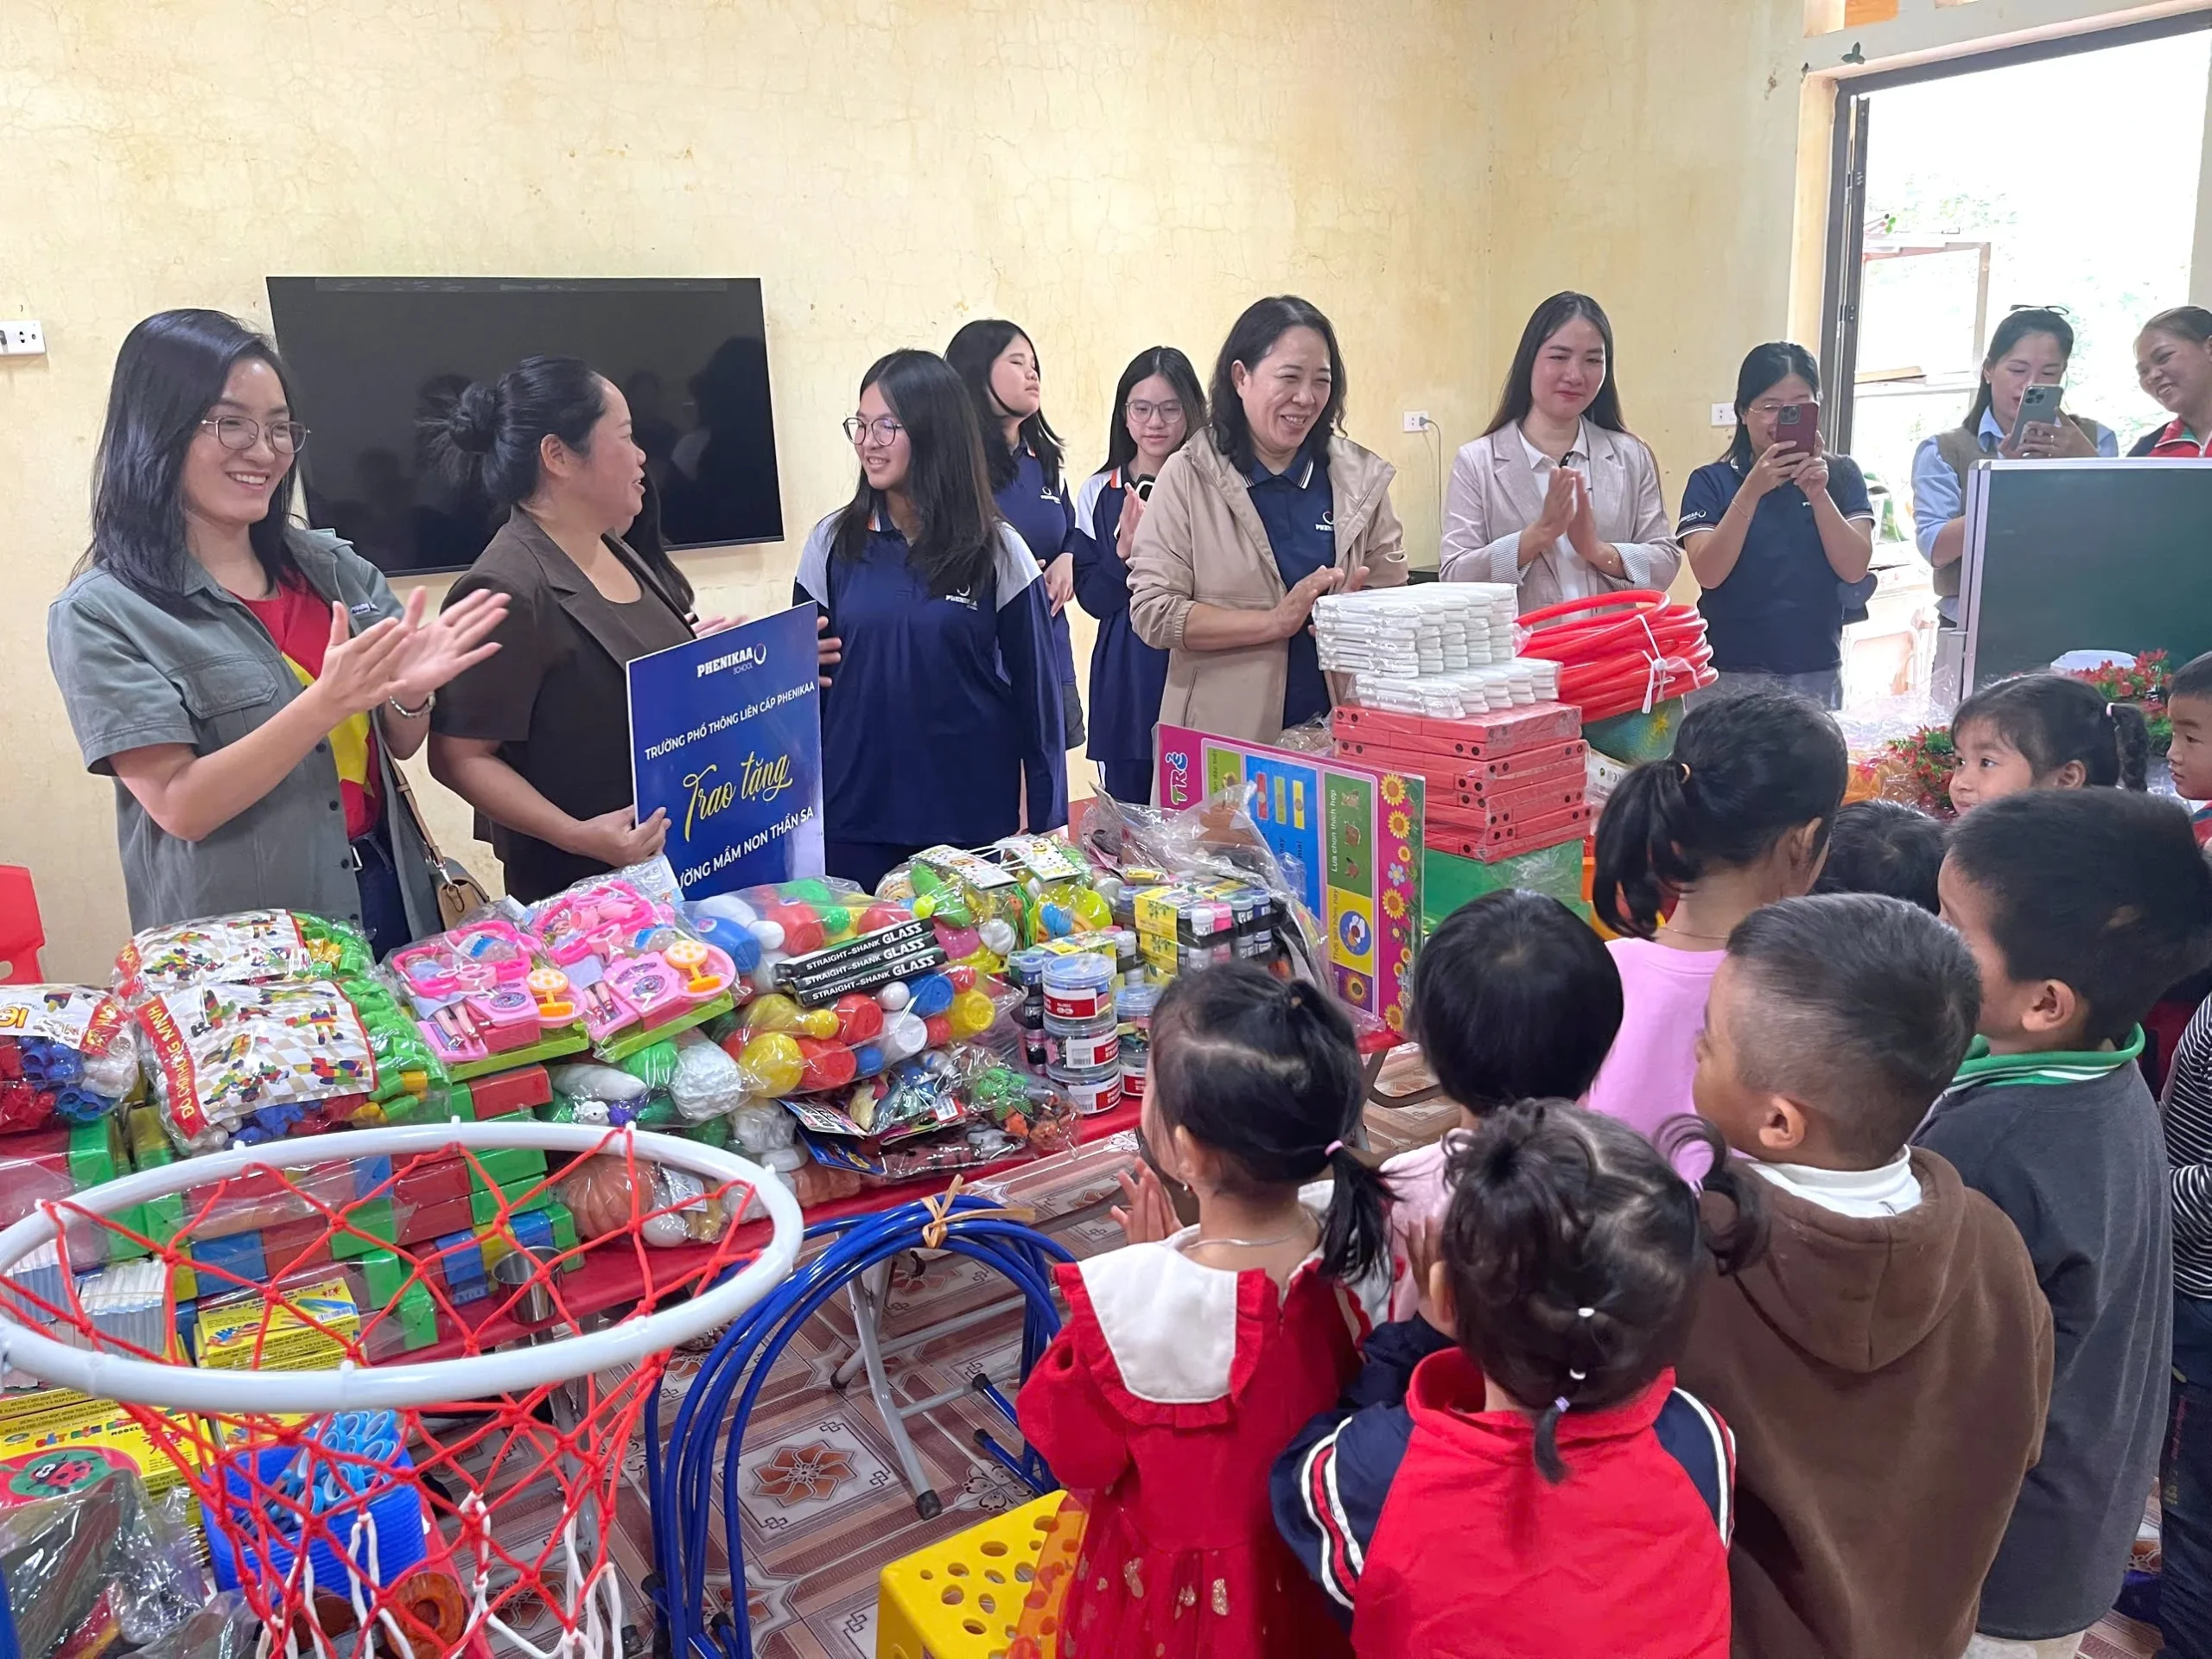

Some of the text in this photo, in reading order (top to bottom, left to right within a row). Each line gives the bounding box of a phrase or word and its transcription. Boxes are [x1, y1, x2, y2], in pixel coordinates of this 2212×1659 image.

[696, 646, 753, 678] PHENIKAA
[733, 662, 753, 675] SCHOOL
[645, 681, 816, 760] TRƯỜNG PHỔ THÔNG LIÊN CẤP PHENIKAA
[683, 751, 793, 842] Trao tặng
[677, 805, 814, 890] ƯỜNG MẦM NON THẦN SA
[881, 922, 924, 945] GLASS
[882, 938, 926, 960] GLASS
[892, 955, 936, 977] GLASS
[111, 1426, 141, 1436] MODEL
